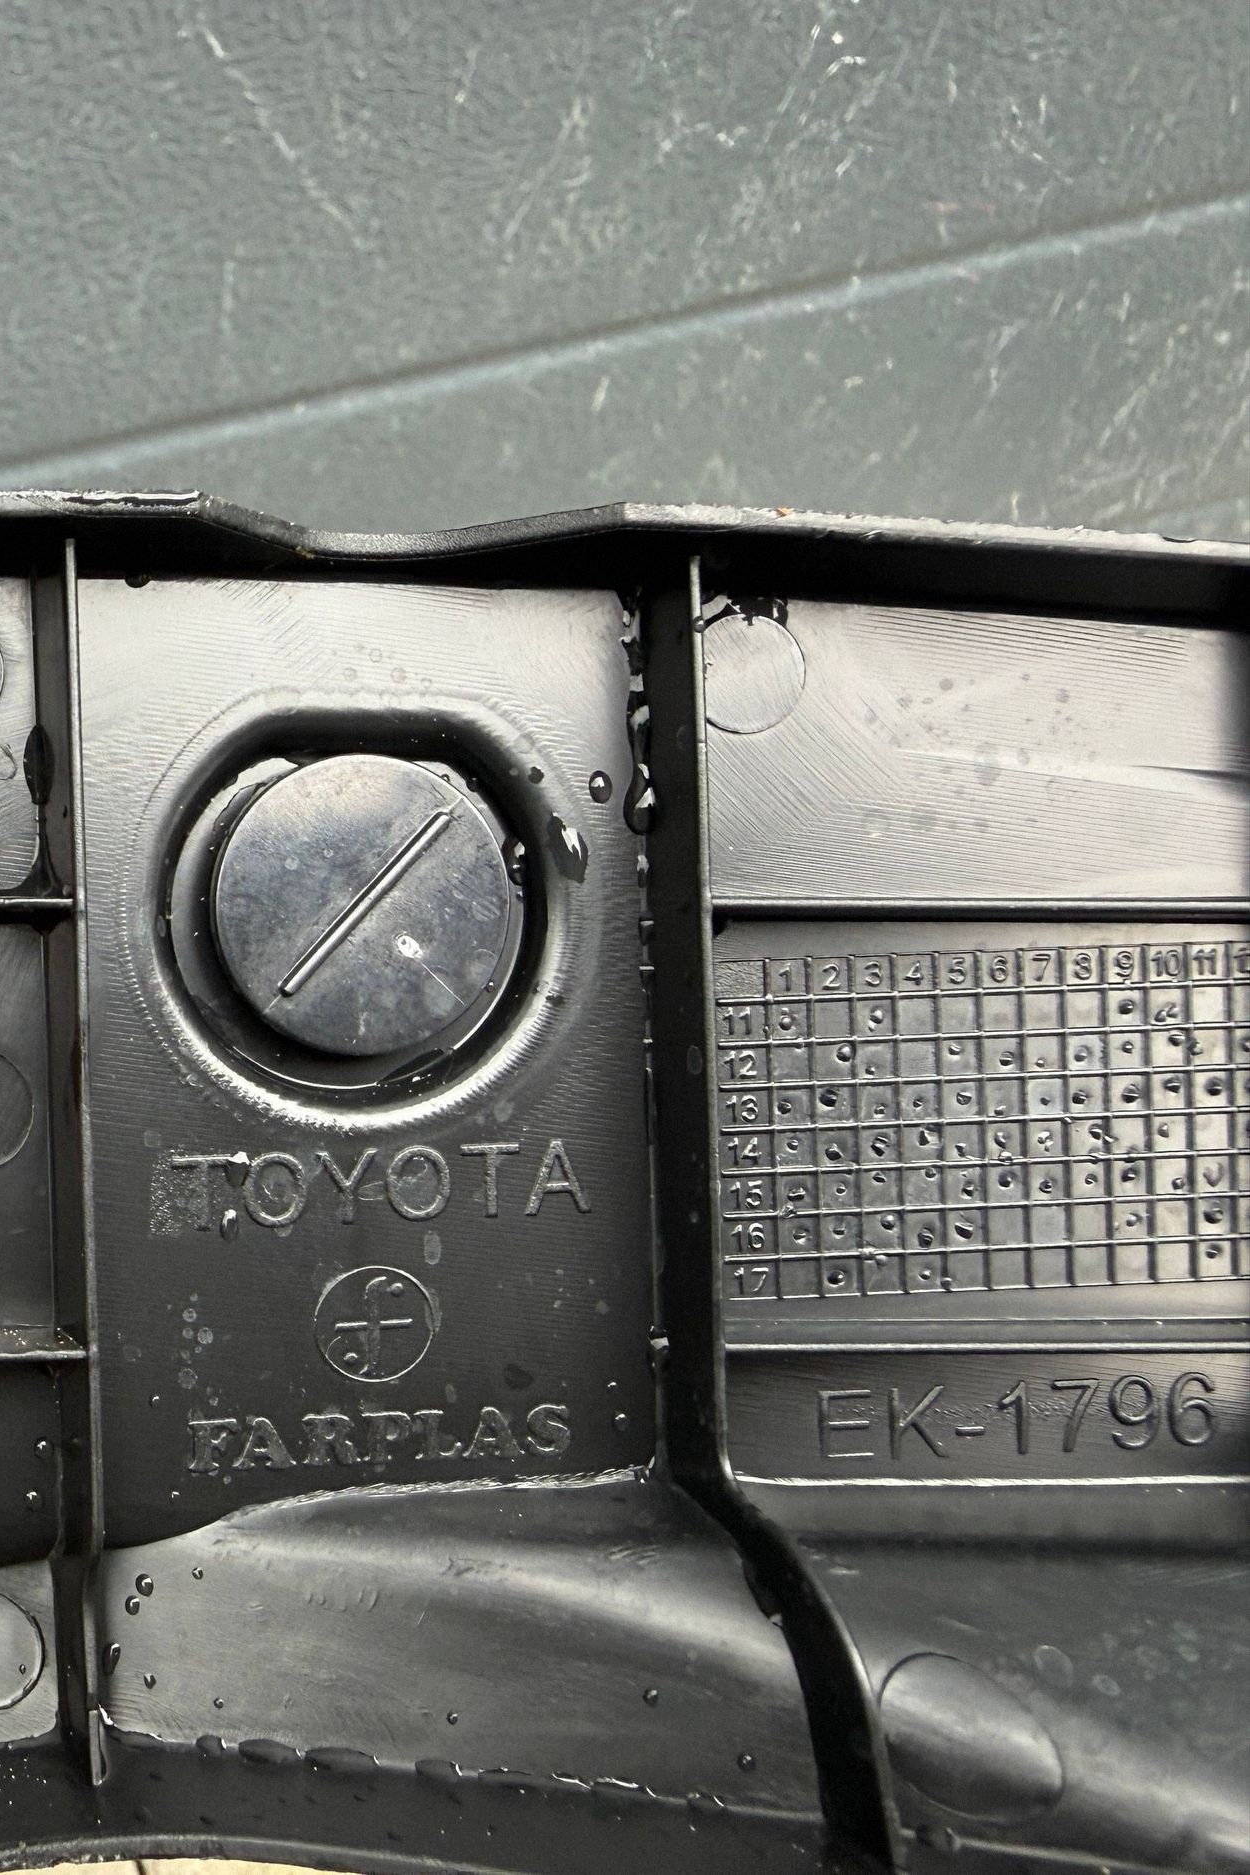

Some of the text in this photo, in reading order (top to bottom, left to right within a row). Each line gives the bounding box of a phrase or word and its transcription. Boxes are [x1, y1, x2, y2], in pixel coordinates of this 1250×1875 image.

[779, 963, 793, 993] 1
[822, 962, 843, 991] 2
[864, 960, 884, 988] 3
[904, 959, 925, 986] 4
[948, 957, 968, 985] 5
[989, 955, 1010, 982] 6
[1031, 953, 1052, 980] 7
[1073, 951, 1094, 979] 8
[1113, 949, 1135, 978] 9
[1150, 948, 1181, 977] 10
[1192, 948, 1217, 975] 11
[722, 1006, 751, 1036] 11
[722, 1050, 758, 1080] 12
[725, 1094, 759, 1124] 13
[727, 1137, 761, 1166] 14
[170, 1139, 592, 1232] TOYOTA
[729, 1180, 763, 1209] 15
[731, 1222, 765, 1251] 16
[733, 1266, 769, 1295] 17
[817, 1371, 1216, 1460] EK-1796
[187, 1403, 572, 1473] FARPLAS
